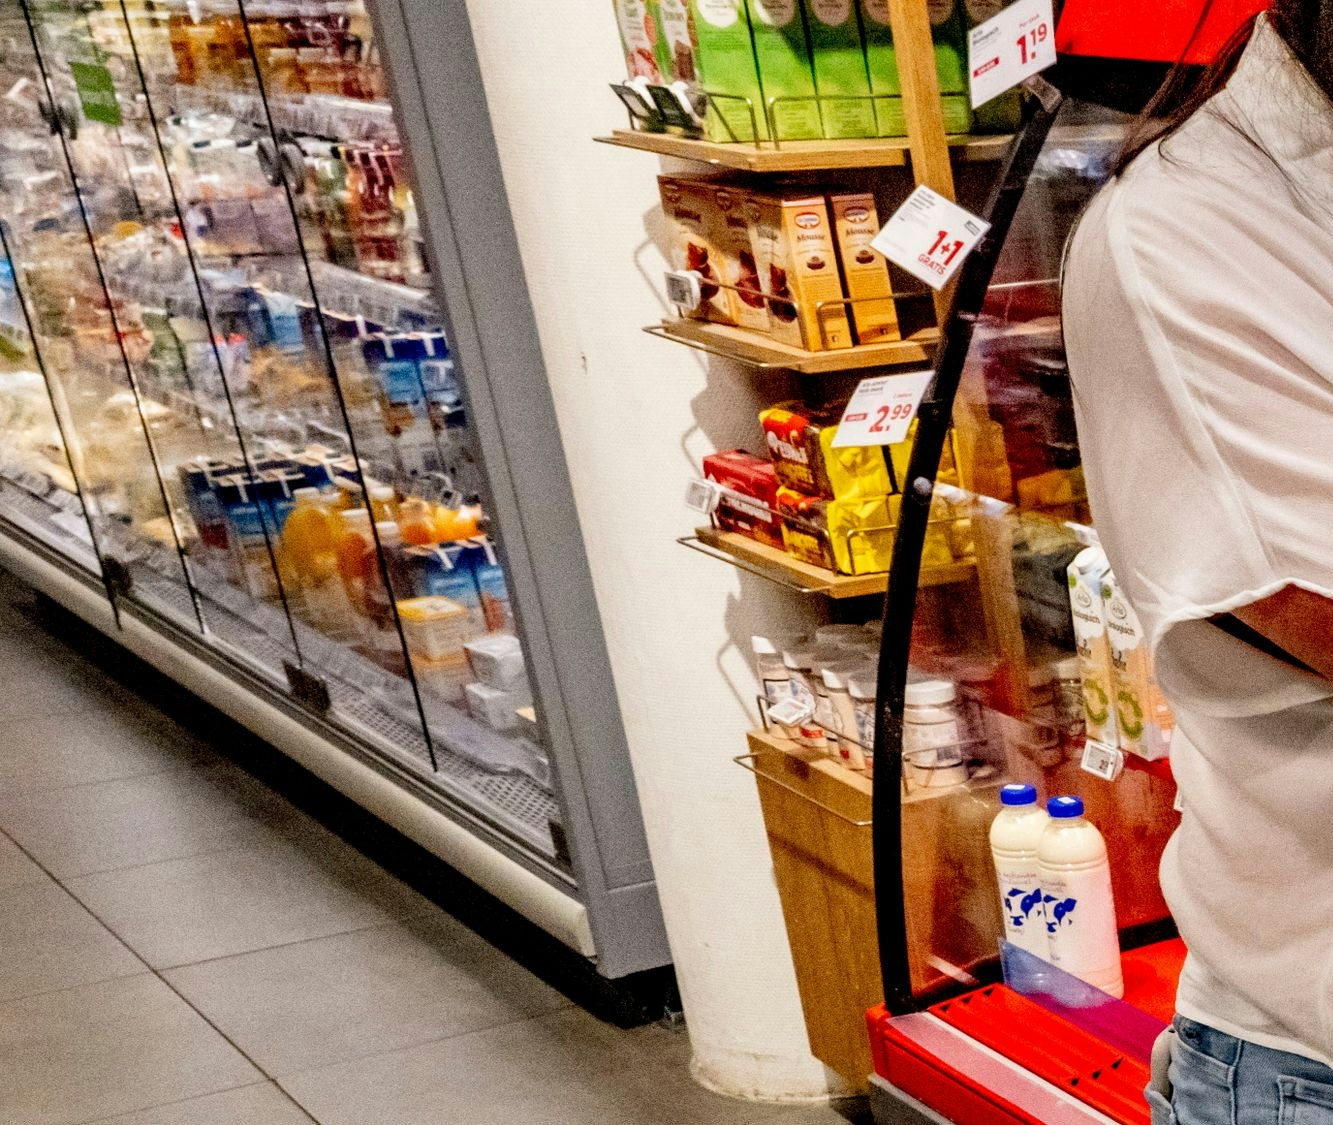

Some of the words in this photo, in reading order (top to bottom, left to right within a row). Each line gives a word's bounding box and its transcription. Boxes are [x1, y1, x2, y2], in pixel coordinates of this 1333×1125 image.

[1017, 23, 1047, 64] 1.19
[927, 230, 964, 266] 1+1
[918, 254, 946, 276] GRATIS
[868, 404, 912, 433] 2.99
